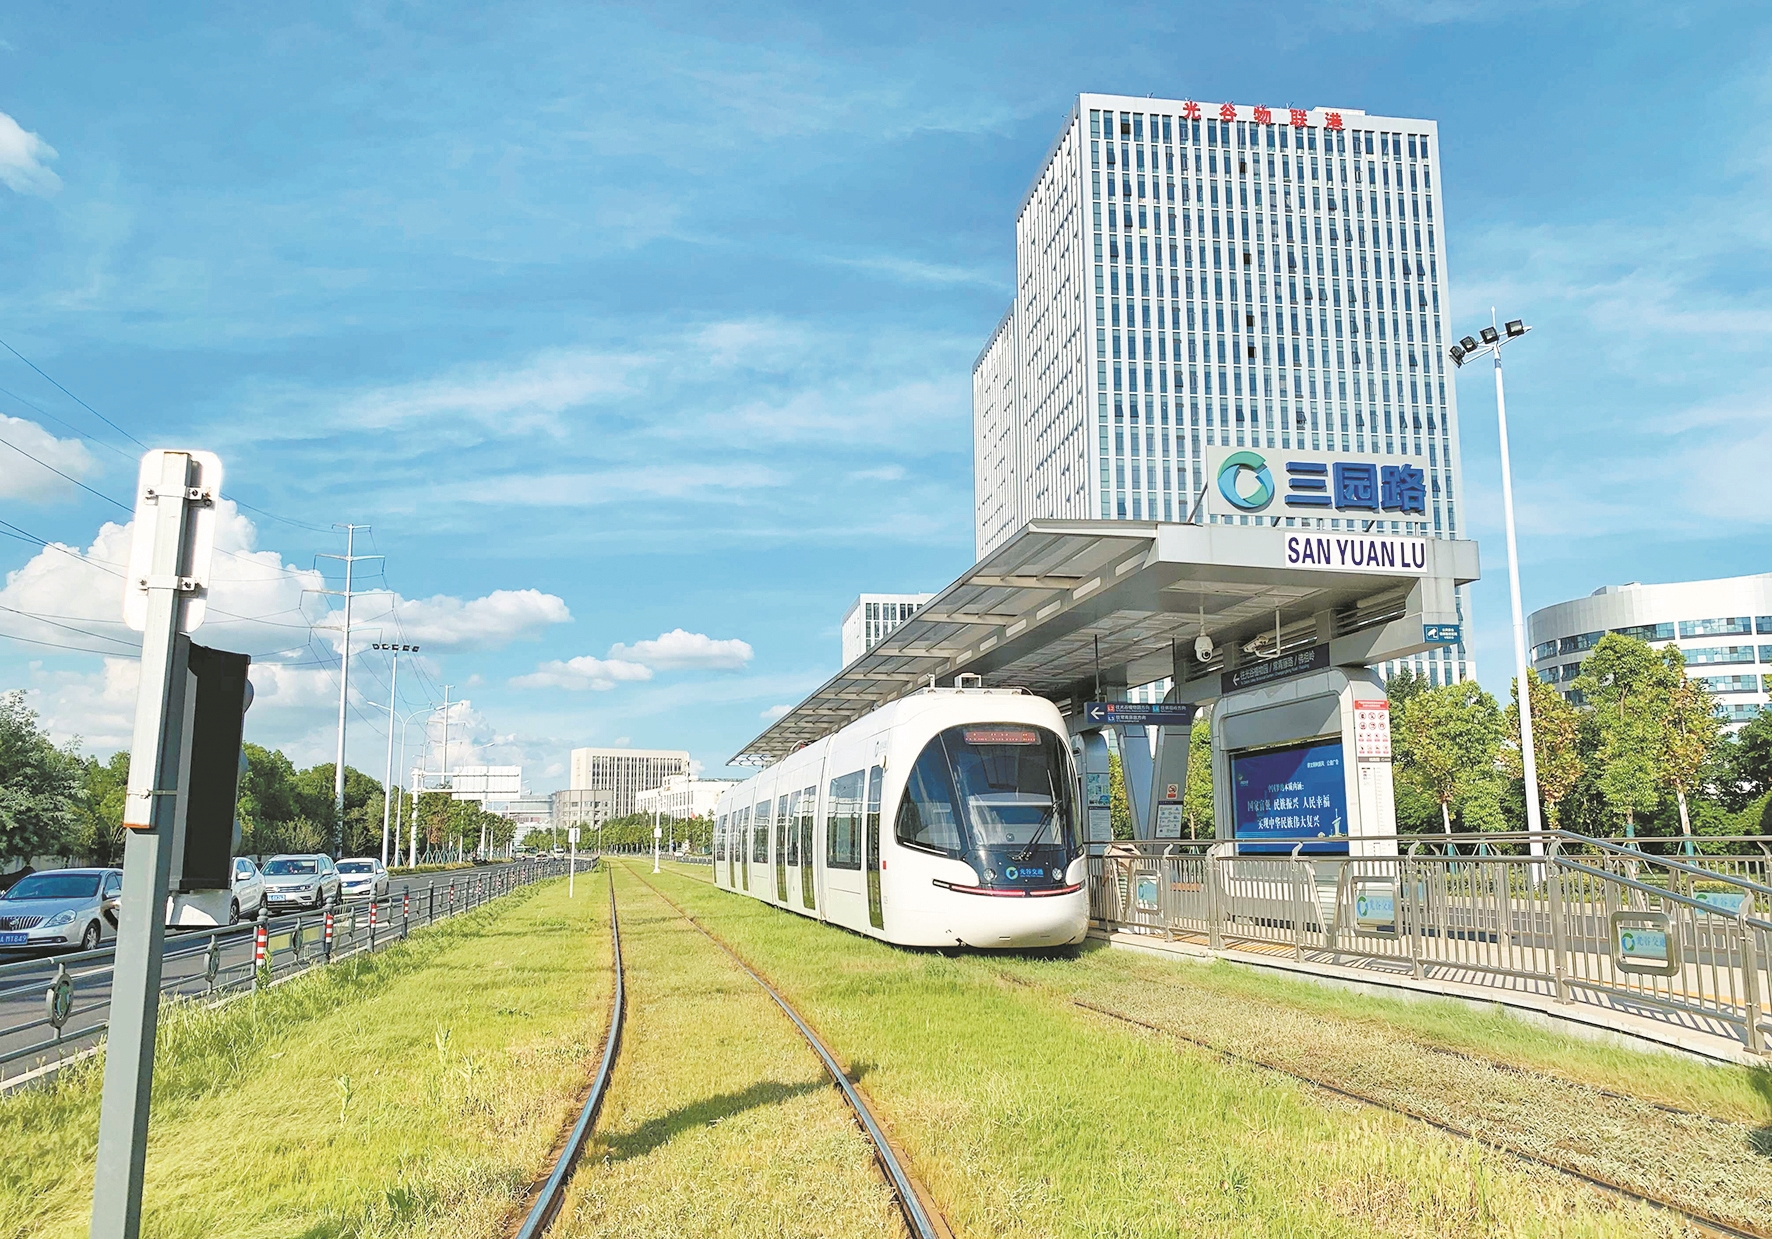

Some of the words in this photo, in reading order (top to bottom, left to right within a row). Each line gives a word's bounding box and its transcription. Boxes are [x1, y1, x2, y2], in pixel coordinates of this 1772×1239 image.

[1183, 101, 1344, 131] 光谷物联港
[1285, 462, 1427, 513] 三园路
[1288, 536, 1331, 565] SAN
[1336, 539, 1395, 568] YUAN
[1401, 541, 1425, 569] LU
[1273, 797, 1299, 811] 民族振兴
[1303, 795, 1330, 809] 人民幸福
[1258, 815, 1320, 830] 实现中华民族伟大复兴
